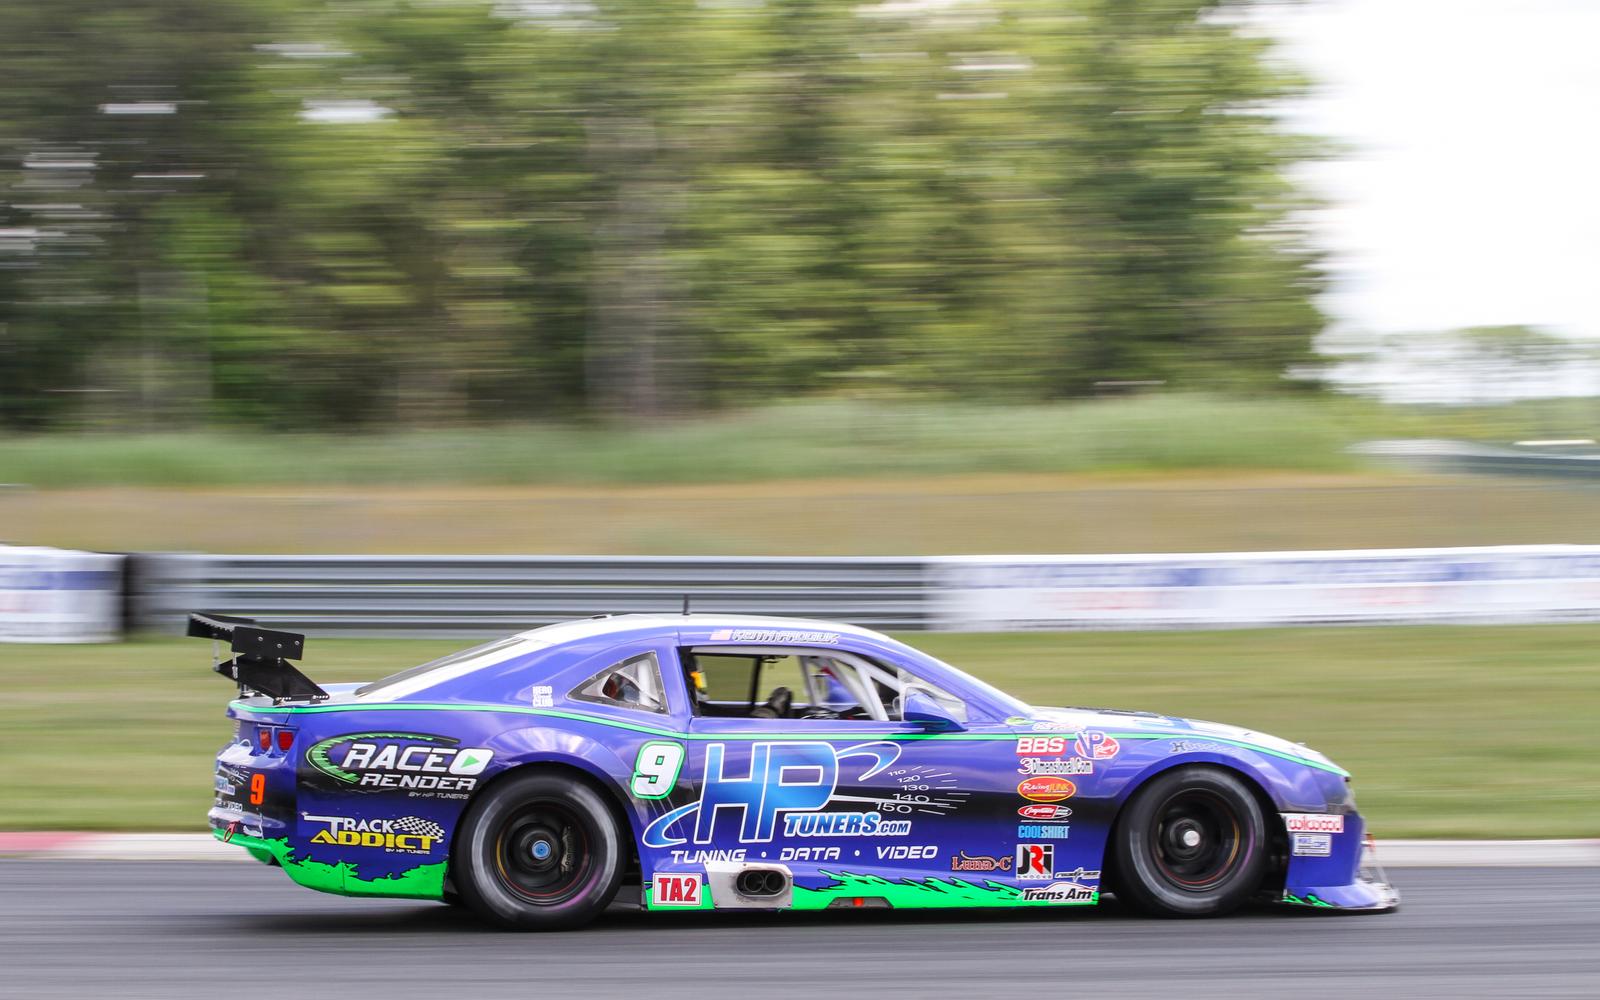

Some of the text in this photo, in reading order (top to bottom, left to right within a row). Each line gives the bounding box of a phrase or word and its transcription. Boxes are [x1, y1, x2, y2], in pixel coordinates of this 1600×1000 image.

[1016, 736, 1065, 755] BBS
[1076, 729, 1106, 759] VP
[342, 743, 460, 772] RACE
[630, 741, 685, 800] 9
[887, 769, 906, 777] 110
[897, 774, 920, 783] 120
[250, 773, 266, 805] 9
[361, 774, 477, 790] RENDER
[437, 792, 470, 800] TUNERS
[693, 741, 839, 845] HP
[892, 793, 930, 803] 140
[874, 801, 912, 814] 150
[304, 815, 395, 838] TRACK
[1018, 825, 1070, 839] COOLSHIRT
[310, 830, 437, 849] ADDICT
[671, 845, 938, 864] TUNING DATA VIDEO
[658, 877, 697, 902] TA2
[1024, 887, 1092, 900] Trans Am
